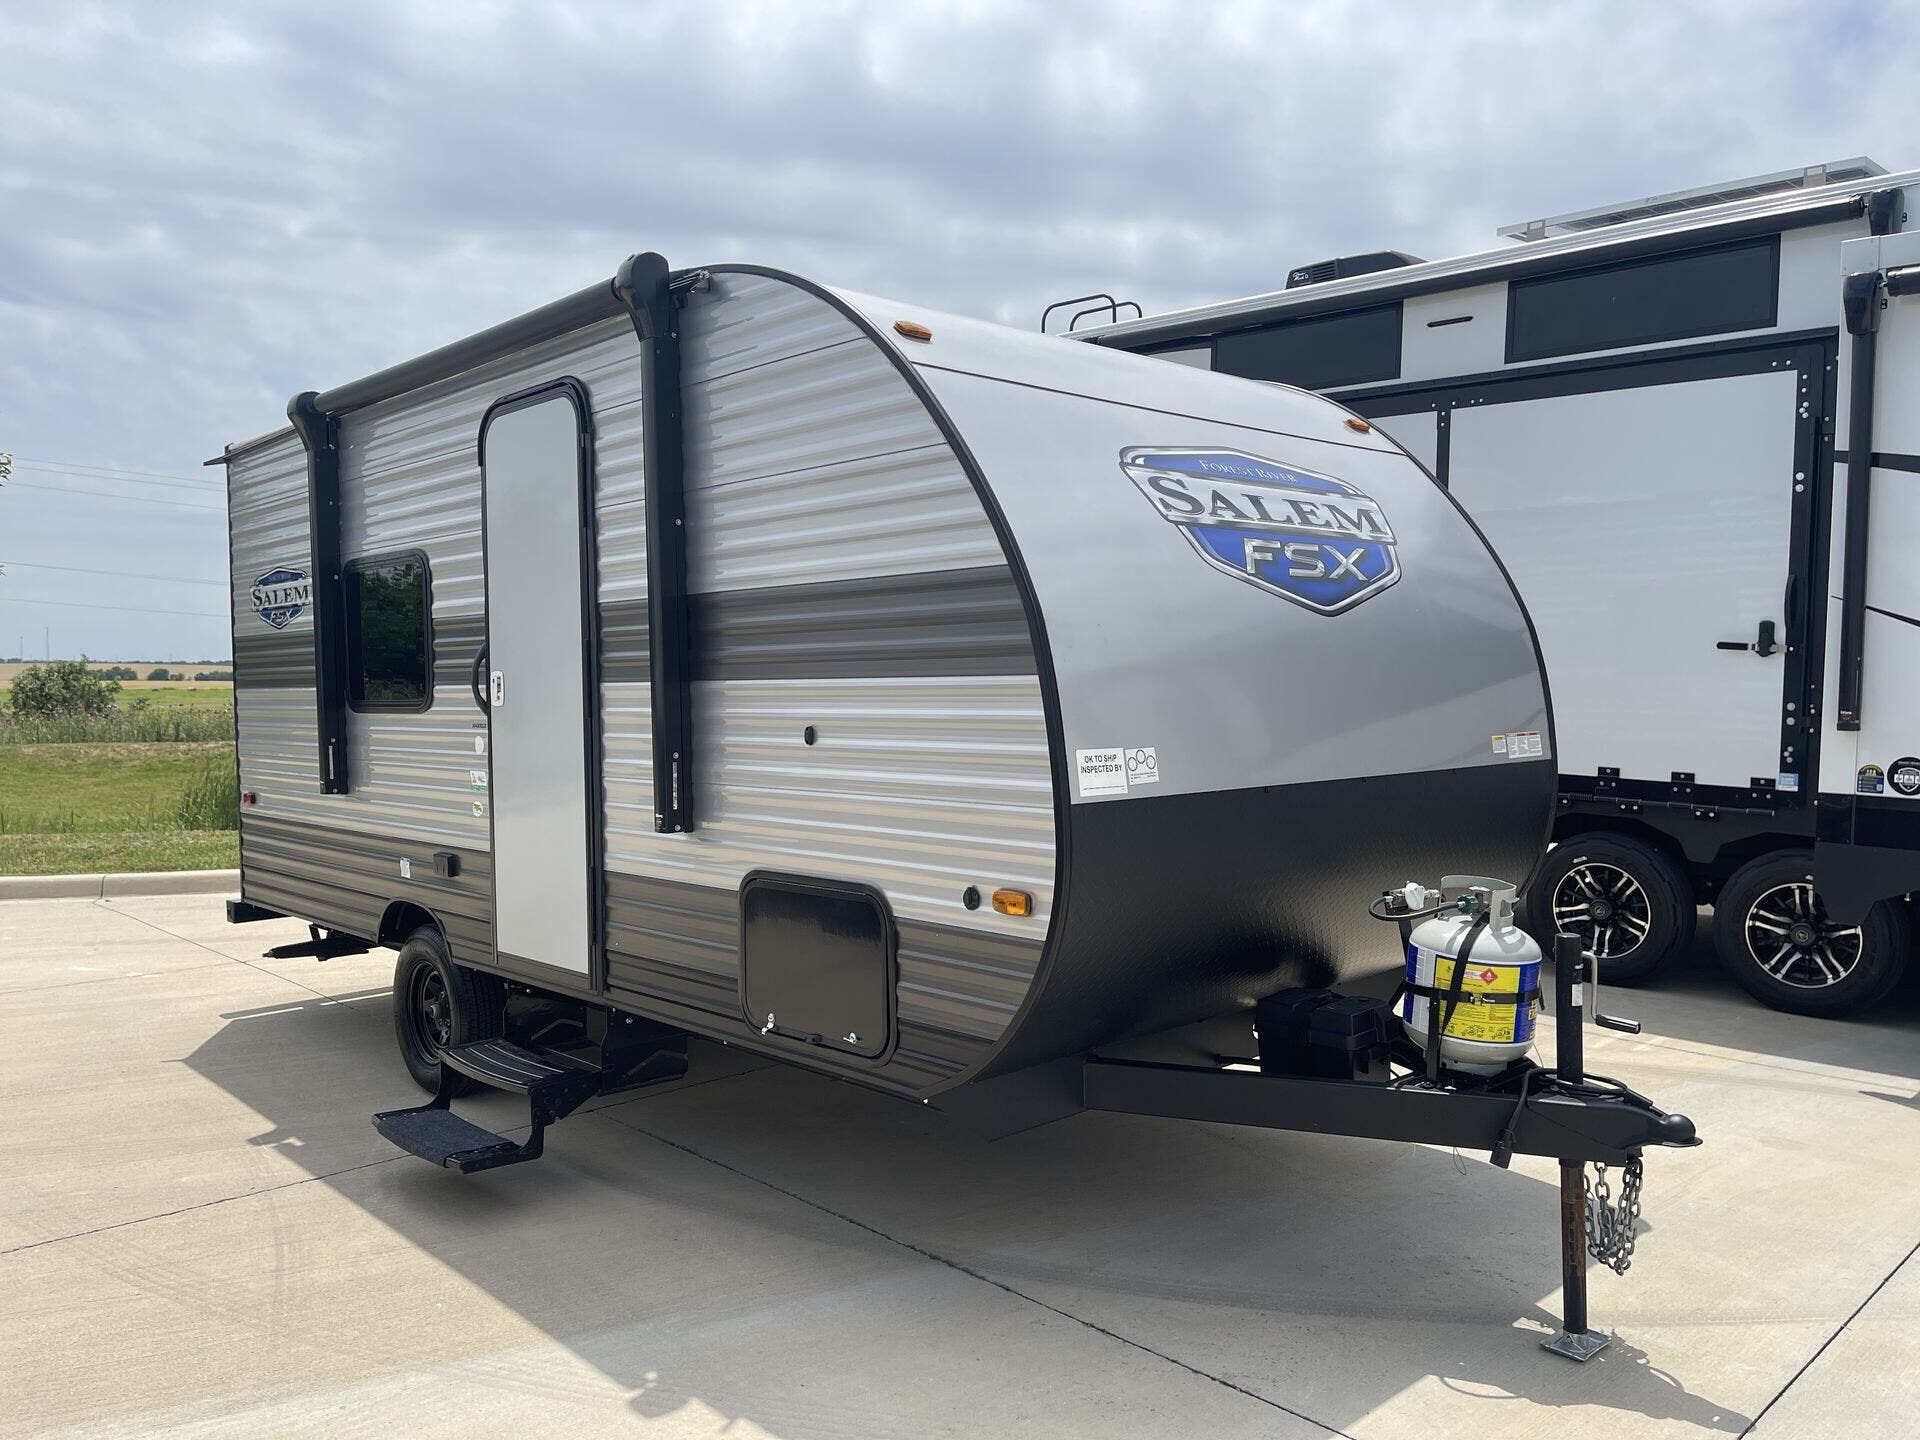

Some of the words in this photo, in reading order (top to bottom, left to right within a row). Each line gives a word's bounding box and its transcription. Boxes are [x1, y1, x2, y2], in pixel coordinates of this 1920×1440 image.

[1199, 459, 1254, 478] FOREST
[1255, 467, 1297, 483] RIVER
[1147, 475, 1389, 536] SALEM
[1243, 537, 1369, 582] FSX
[252, 585, 309, 607] SALEM
[1081, 765, 1114, 773] INSPECTED
[1115, 763, 1122, 772] BY
[1084, 755, 1094, 763] OK
[1095, 754, 1103, 762] TO
[1104, 754, 1117, 762] SHIP
